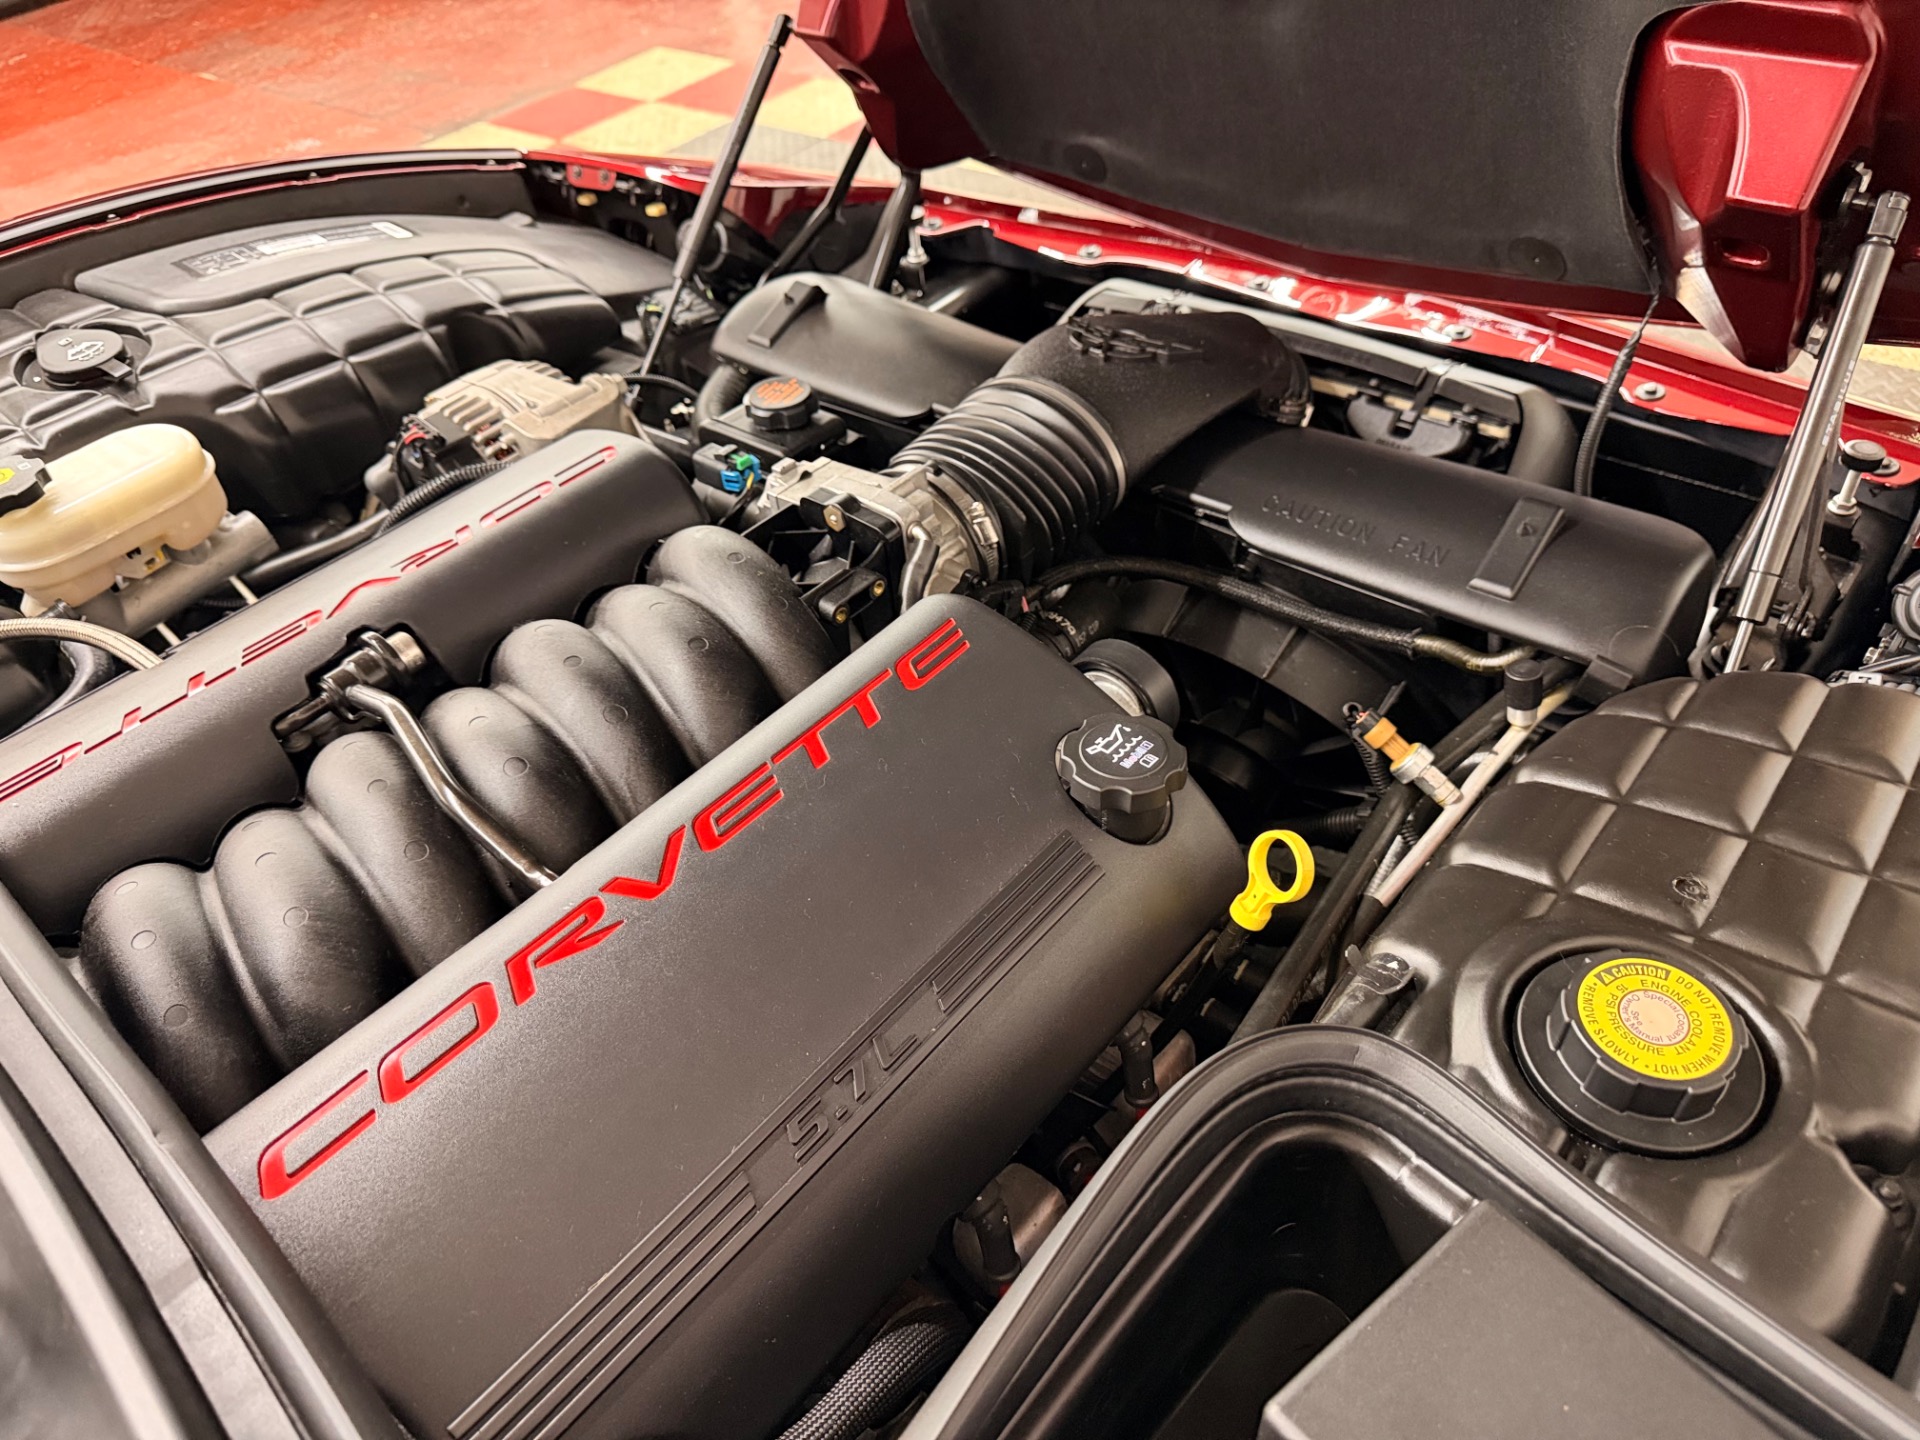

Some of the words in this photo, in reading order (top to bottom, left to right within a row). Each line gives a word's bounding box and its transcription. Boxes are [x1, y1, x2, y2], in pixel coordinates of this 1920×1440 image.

[1822, 360, 1855, 446] STABILUS
[1262, 495, 1377, 544] CAUTION
[1388, 535, 1450, 568] FAN
[0, 446, 618, 802] CORVETTE
[257, 617, 970, 1200] CORVETTE
[1611, 964, 1667, 980] CAUTION
[1616, 983, 1629, 994] 15
[1675, 976, 1694, 990] DO
[1605, 992, 1618, 1010] PSI
[1621, 993, 1641, 1023] Owner's
[1630, 1010, 1643, 1027] See
[1640, 979, 1692, 1008] ENGINE
[1674, 1010, 1704, 1056] COOLANT
[1643, 990, 1678, 1013] Special
[1667, 1013, 1686, 1043] Coolant
[1693, 990, 1717, 1011] NOT
[1583, 984, 1599, 1026] REMOVE
[1594, 1028, 1640, 1065] SLOWLY
[1606, 1010, 1666, 1056] PRESSURE
[1629, 1023, 1664, 1043] Manual
[1709, 1012, 1726, 1056] REMOVE
[1653, 1063, 1680, 1076] HOT
[1681, 1053, 1717, 1075] WHEN
[786, 1034, 918, 1163] 5.7L
